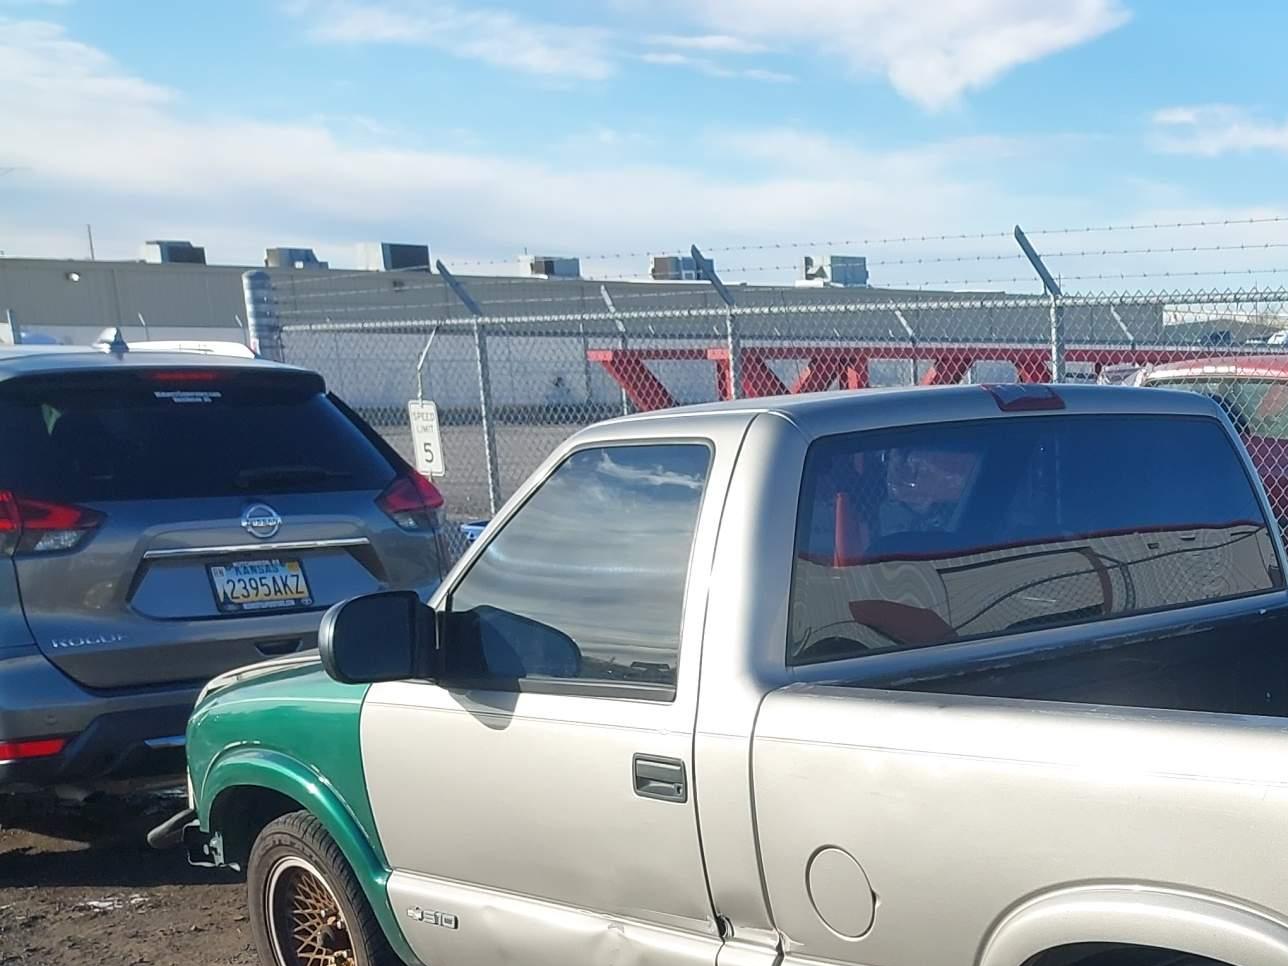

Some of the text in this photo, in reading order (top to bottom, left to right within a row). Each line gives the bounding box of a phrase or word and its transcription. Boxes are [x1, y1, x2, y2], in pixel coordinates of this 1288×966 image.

[412, 411, 434, 421] SPEED
[416, 424, 434, 433] LIMIT
[423, 442, 434, 463] 5
[235, 563, 280, 576] KANSAS
[227, 574, 304, 600] 2395AKZ
